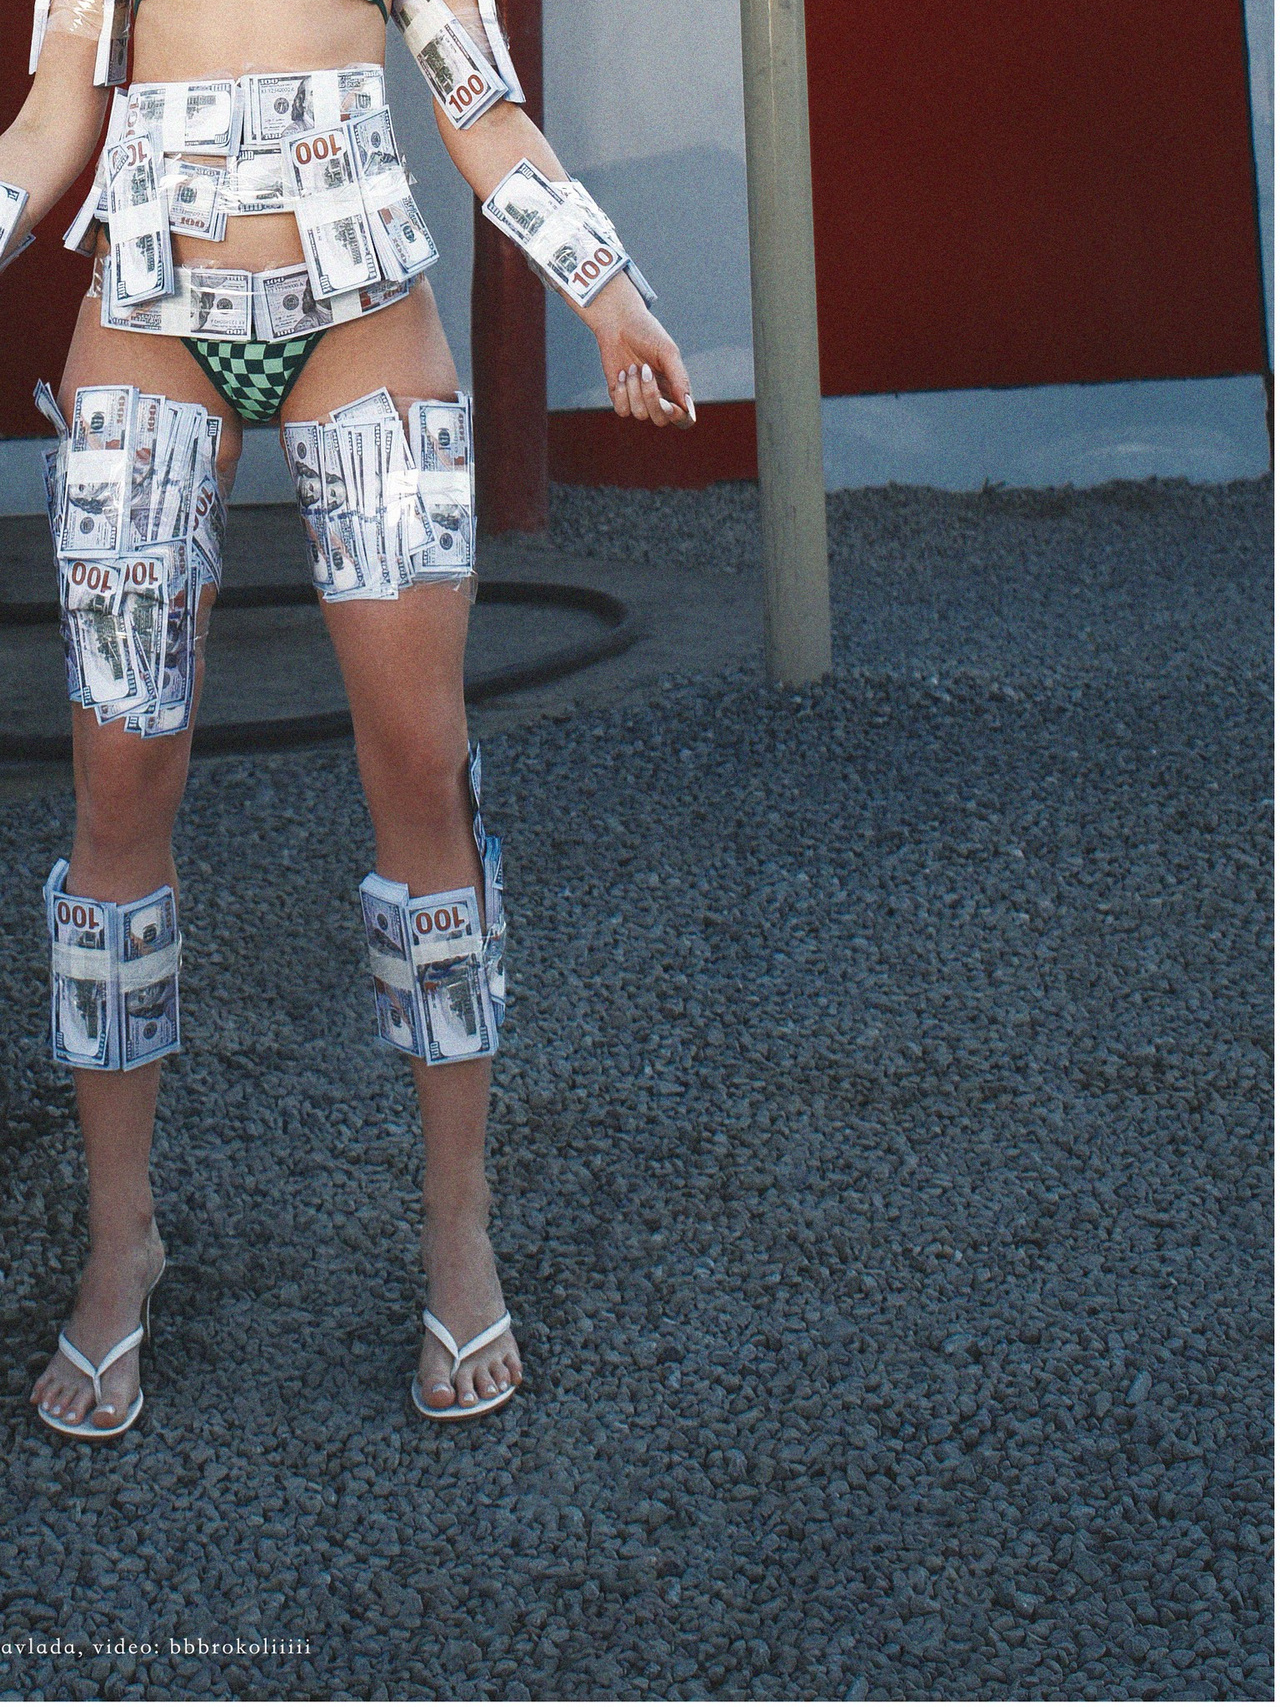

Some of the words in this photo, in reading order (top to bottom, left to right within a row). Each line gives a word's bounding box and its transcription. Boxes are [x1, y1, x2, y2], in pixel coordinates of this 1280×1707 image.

[448, 74, 484, 113] 100
[294, 133, 342, 166] 100
[572, 247, 614, 288] 100
[72, 562, 112, 593] 100
[125, 561, 158, 586] 10
[57, 900, 99, 930] 100
[415, 906, 465, 935] 100
